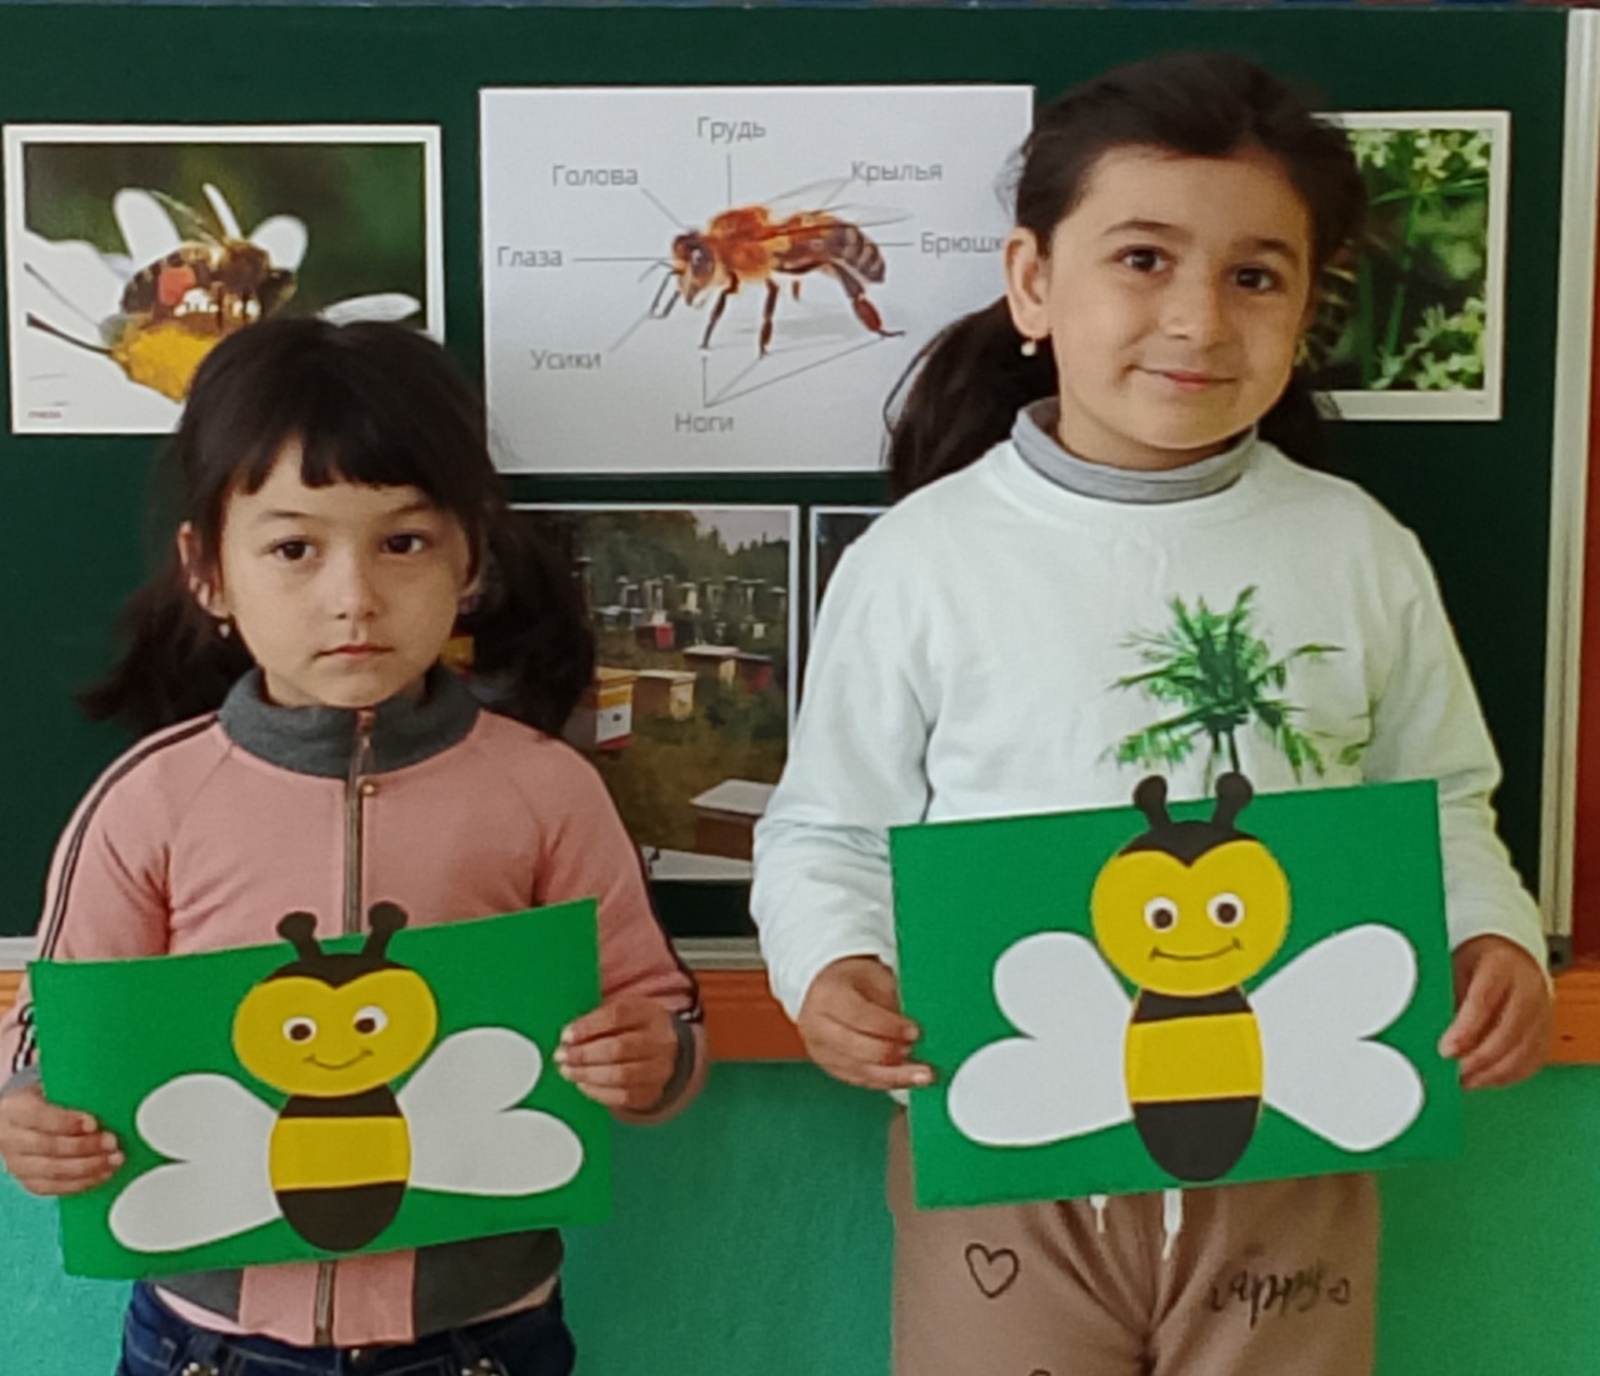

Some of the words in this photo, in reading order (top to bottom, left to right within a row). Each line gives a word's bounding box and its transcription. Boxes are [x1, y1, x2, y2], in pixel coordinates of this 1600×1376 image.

[697, 116, 766, 144] Грудь
[552, 165, 639, 187] Голова
[851, 161, 943, 188] Крылья
[497, 246, 563, 268] Глаза
[530, 350, 602, 370] Усики
[674, 413, 734, 433] Ноги
